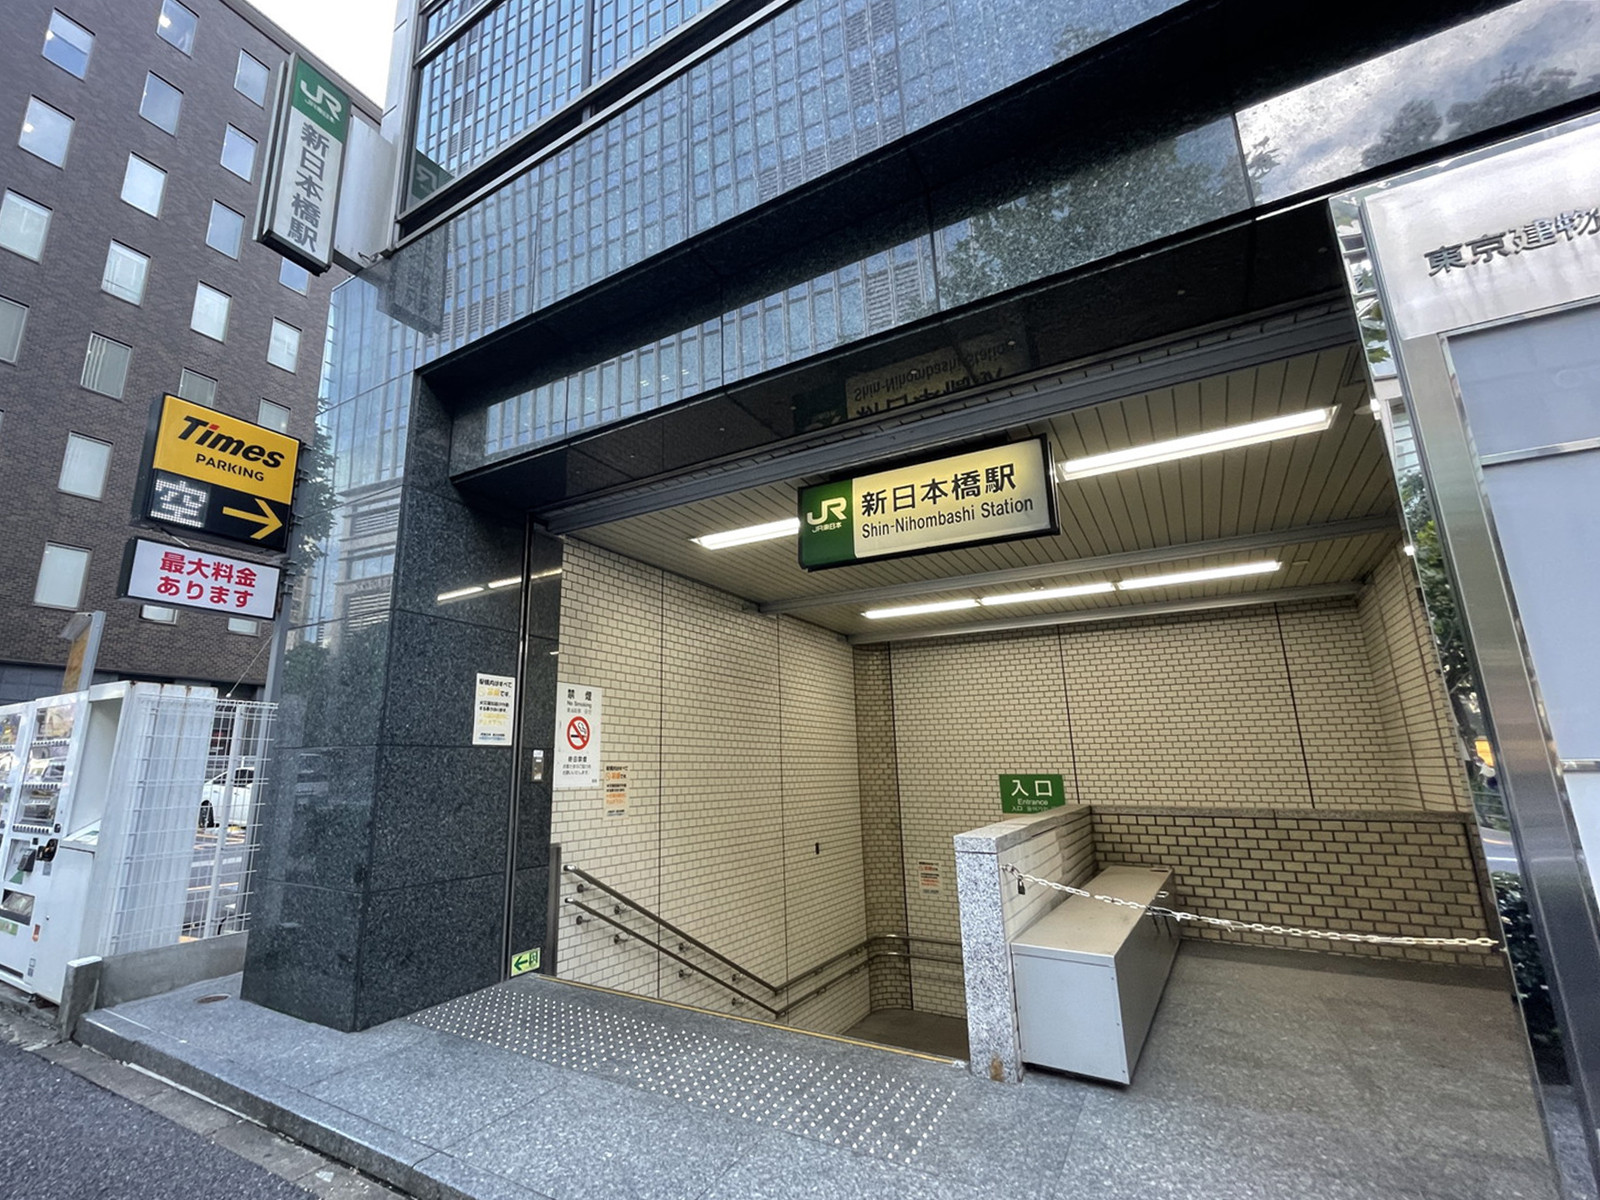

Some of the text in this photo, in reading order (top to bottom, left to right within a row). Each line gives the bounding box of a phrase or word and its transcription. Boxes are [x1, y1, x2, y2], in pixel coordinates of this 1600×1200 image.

[300, 79, 342, 121] JR
[287, 122, 330, 253] 新日本橋駅
[178, 415, 285, 468] Times
[195, 453, 264, 482] PARKING
[150, 479, 206, 528] 空
[861, 463, 1016, 517] 新日本橋駅
[806, 496, 847, 525] JR
[861, 498, 1034, 539] Shin-Nihombashi Station
[160, 551, 257, 588] 最大料金
[157, 576, 254, 608] あります
[1011, 779, 1053, 797] 入口
[1017, 798, 1049, 806] Entrance
